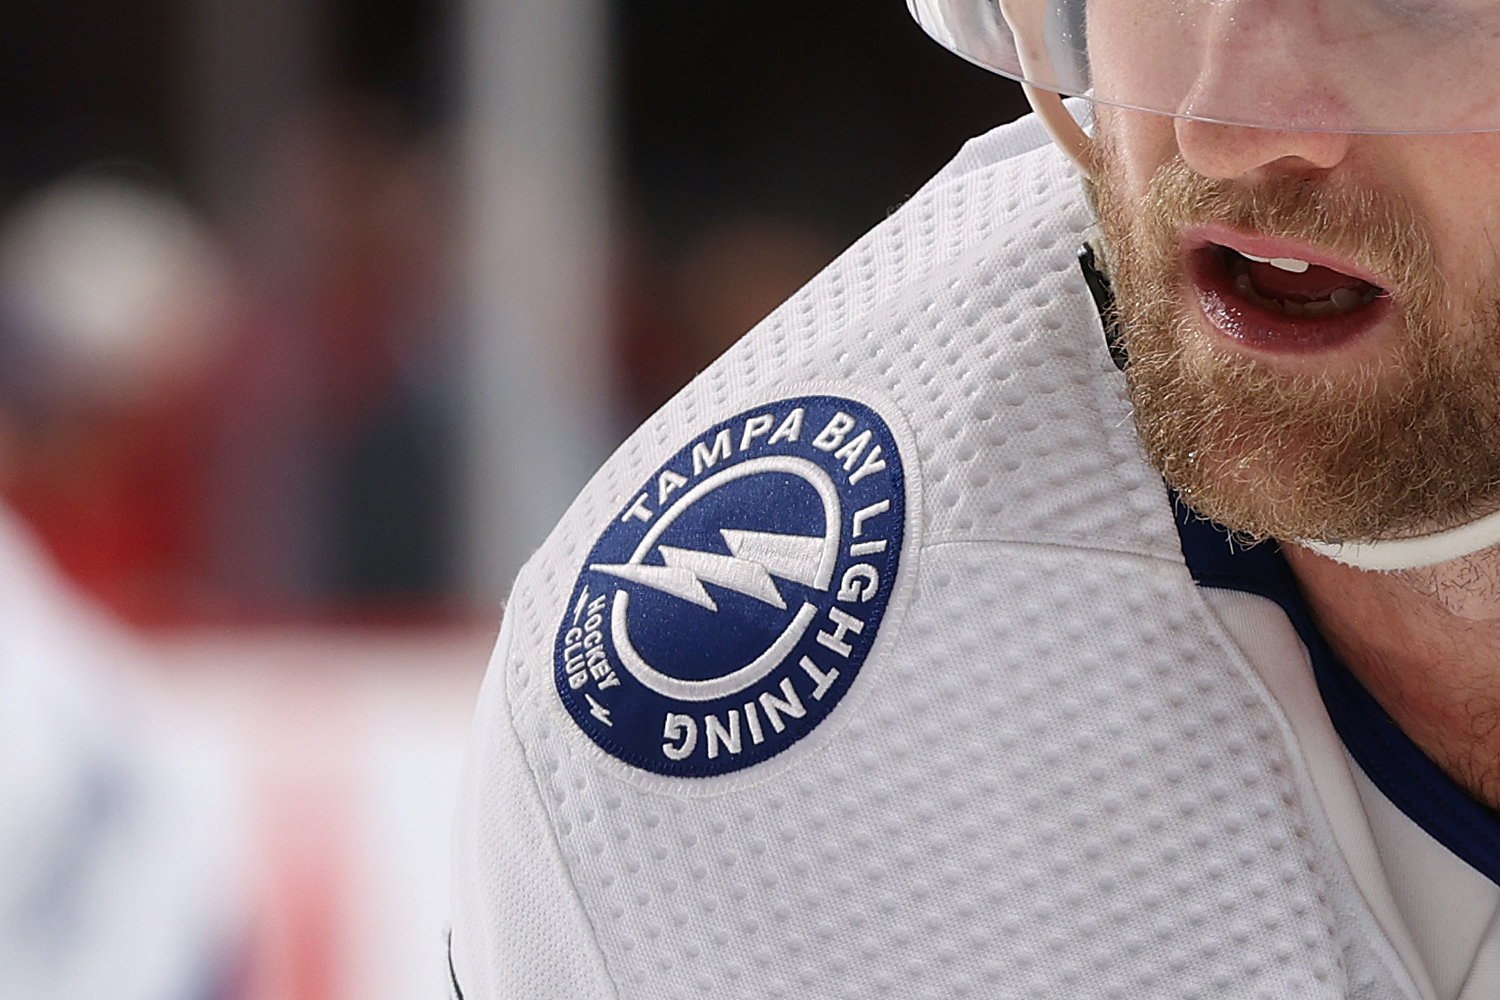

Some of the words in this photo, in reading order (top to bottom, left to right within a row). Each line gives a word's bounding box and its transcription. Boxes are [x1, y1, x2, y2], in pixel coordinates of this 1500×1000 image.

[621, 407, 806, 525] TAMPA
[812, 411, 888, 485] BAY
[564, 626, 588, 689] CLUB
[584, 594, 621, 690] HOCKEY
[662, 498, 890, 761] LIGHTNING
